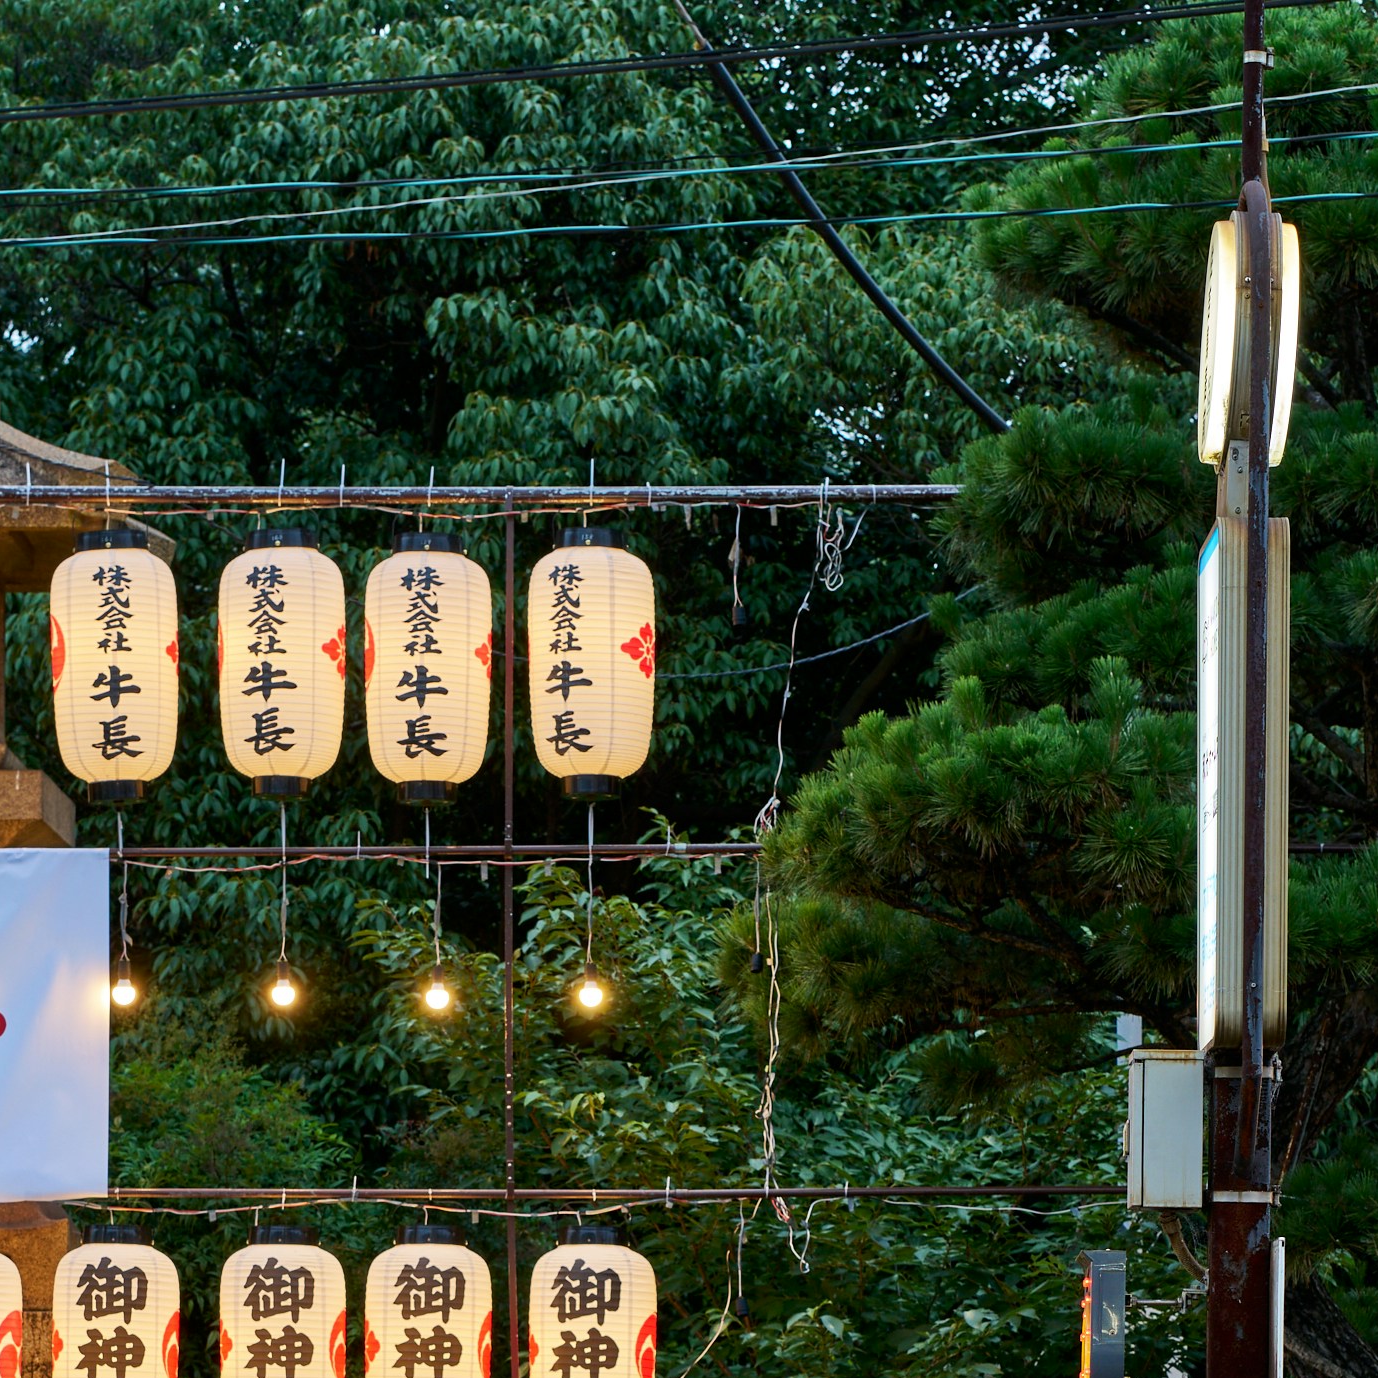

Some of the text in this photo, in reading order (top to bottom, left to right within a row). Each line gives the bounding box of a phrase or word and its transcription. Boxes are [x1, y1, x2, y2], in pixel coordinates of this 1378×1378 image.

[91, 566, 143, 760] 株式会社牛長
[242, 565, 297, 755] 株式会社牛長
[396, 567, 448, 758] 株式会社牛長
[547, 565, 593, 755] 株式会社牛長
